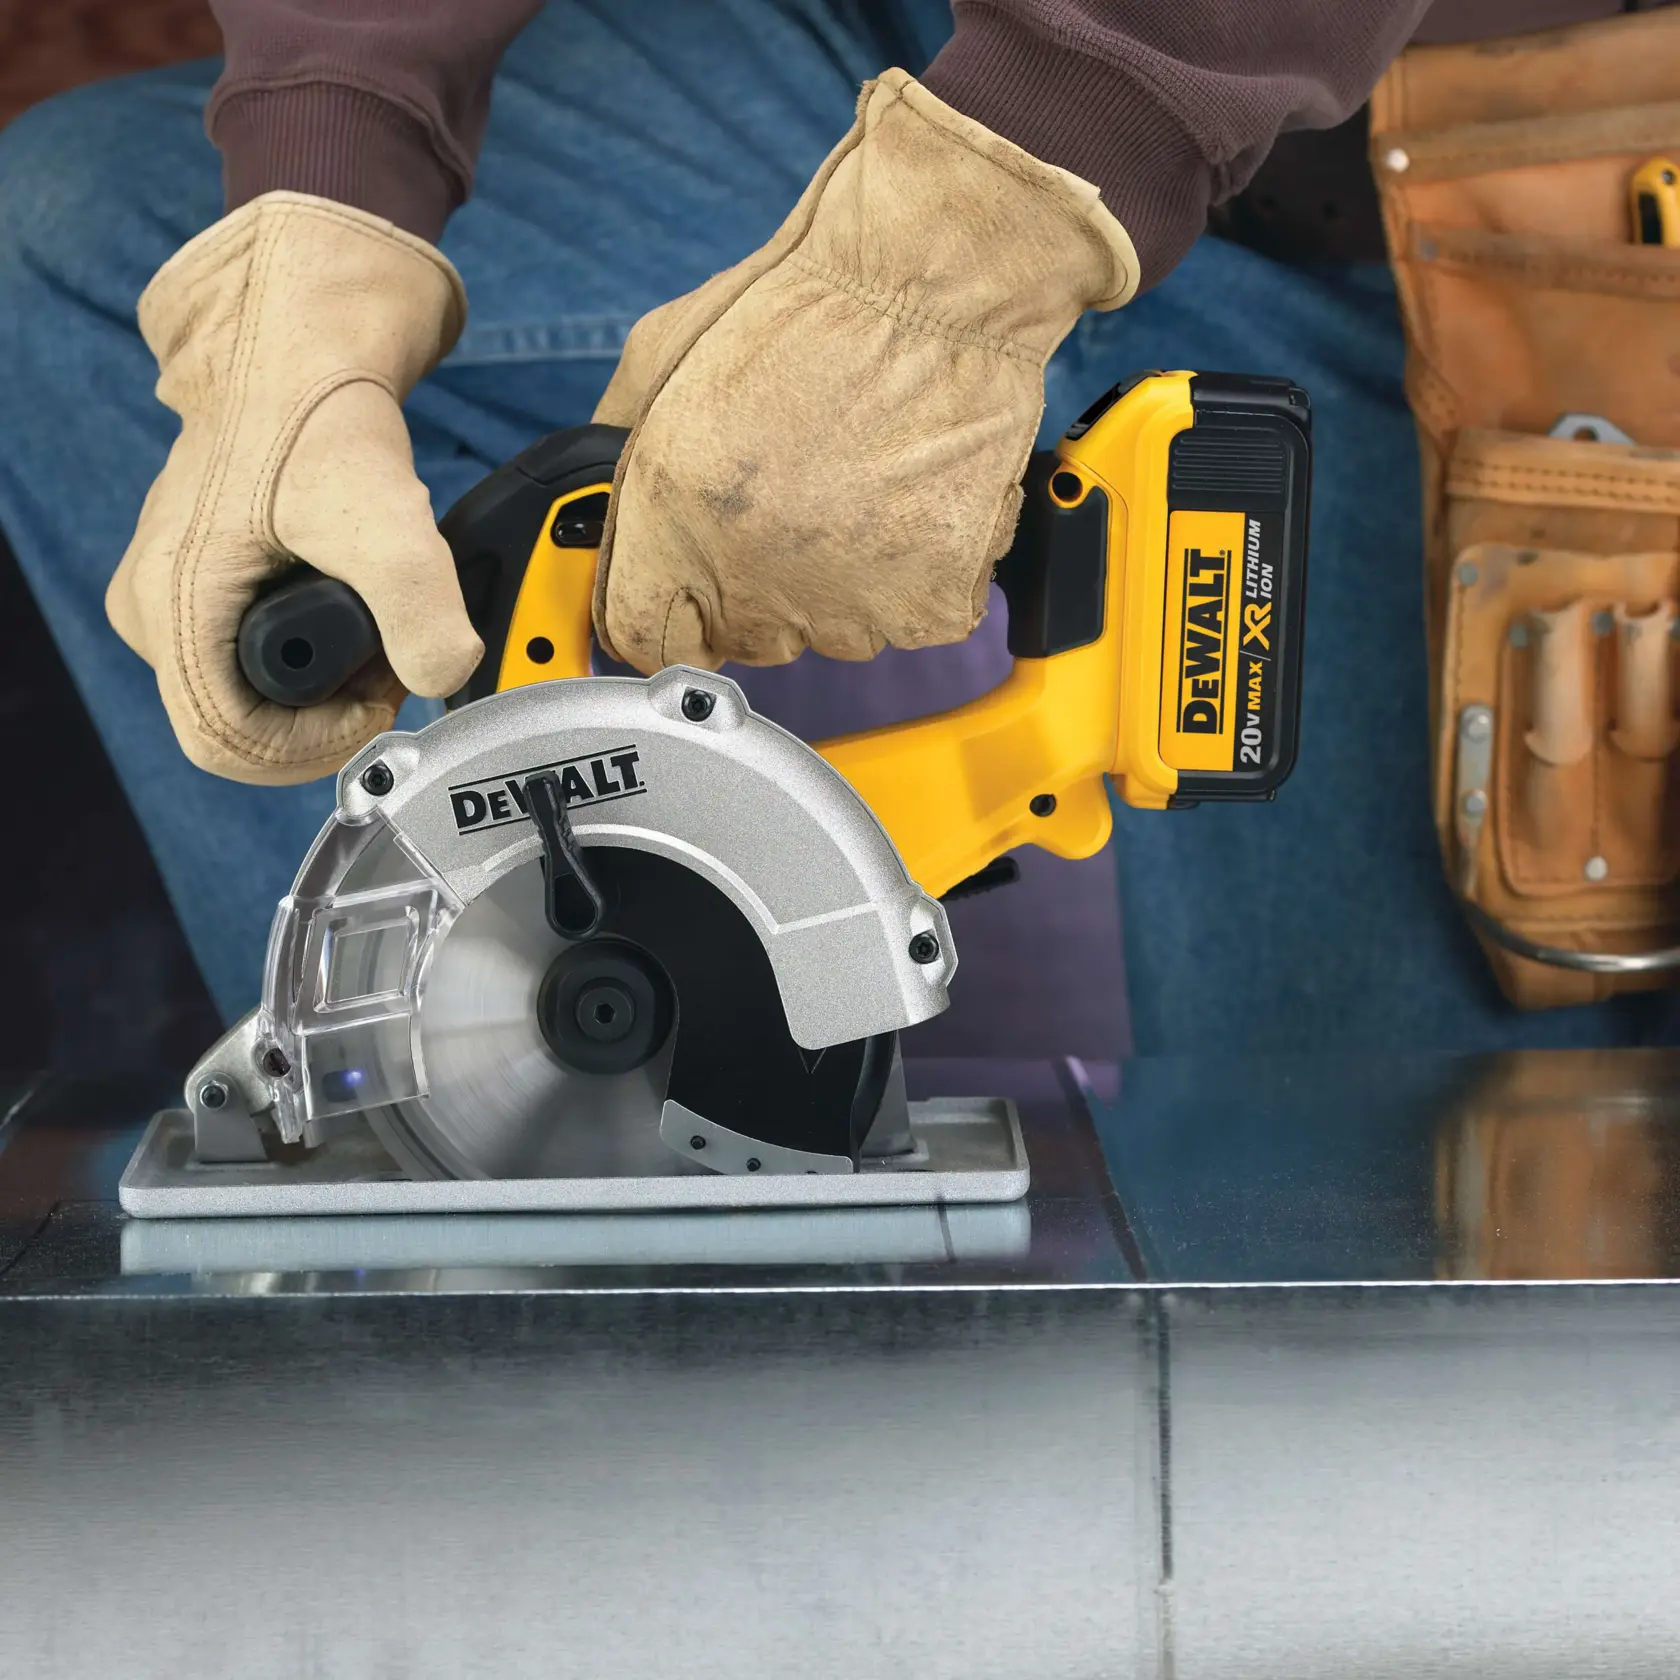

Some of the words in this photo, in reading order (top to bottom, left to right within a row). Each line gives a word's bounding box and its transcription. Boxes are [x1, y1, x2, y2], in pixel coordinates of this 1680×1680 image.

[1245, 518, 1261, 599] LITHIUM
[1260, 563, 1274, 599] ION
[1243, 601, 1272, 651] XR
[1247, 660, 1263, 711] MAX
